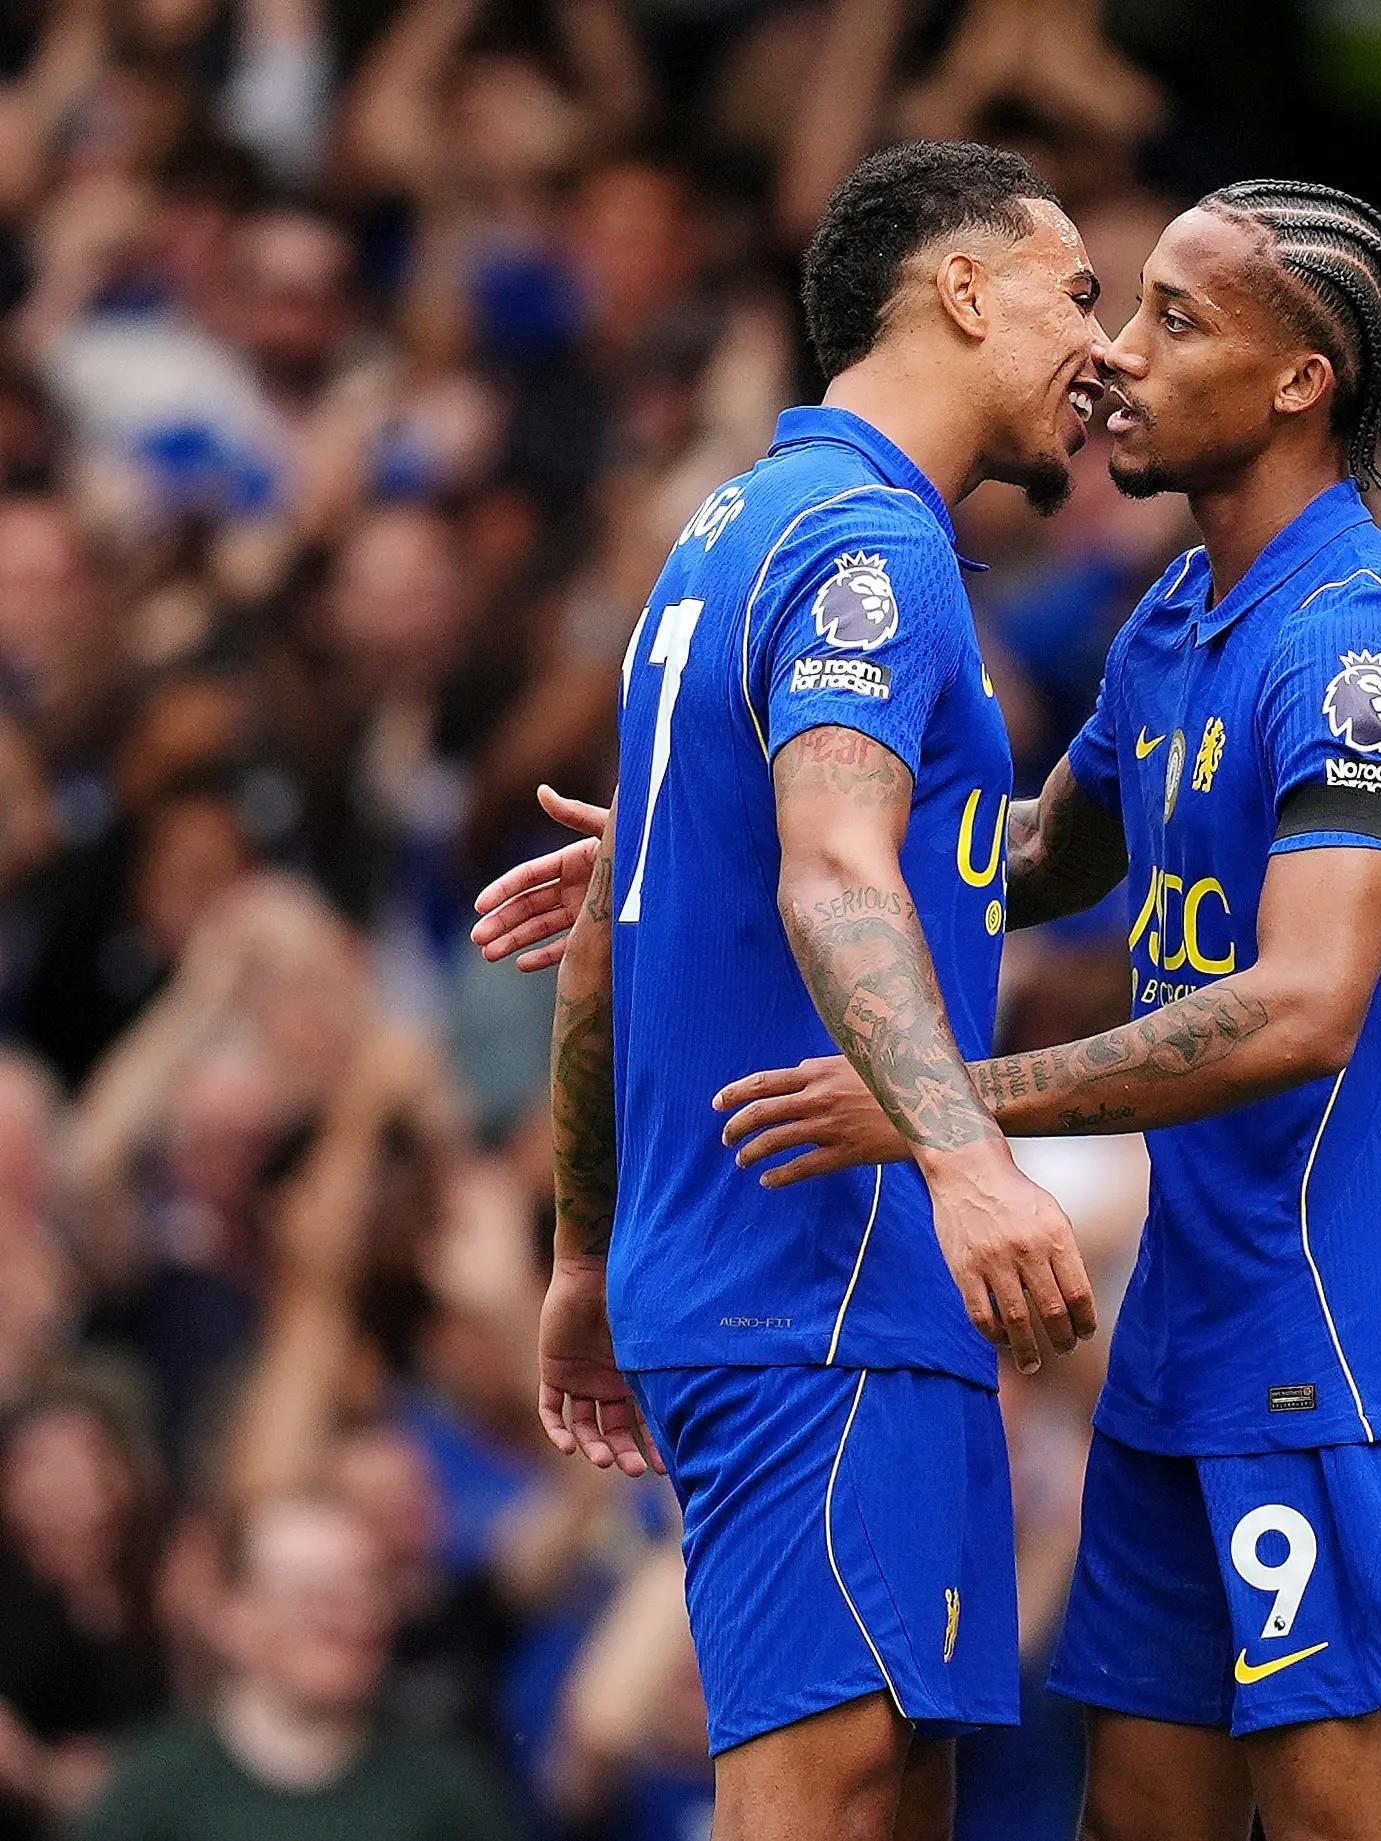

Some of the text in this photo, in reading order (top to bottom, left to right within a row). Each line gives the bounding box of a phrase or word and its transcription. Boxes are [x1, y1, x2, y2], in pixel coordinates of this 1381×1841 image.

[794, 658, 882, 682] No room
[820, 675, 890, 699] racism
[1326, 758, 1358, 779] No
[720, 1316, 793, 1328] AERO-FIT
[1230, 1503, 1318, 1639] 9
